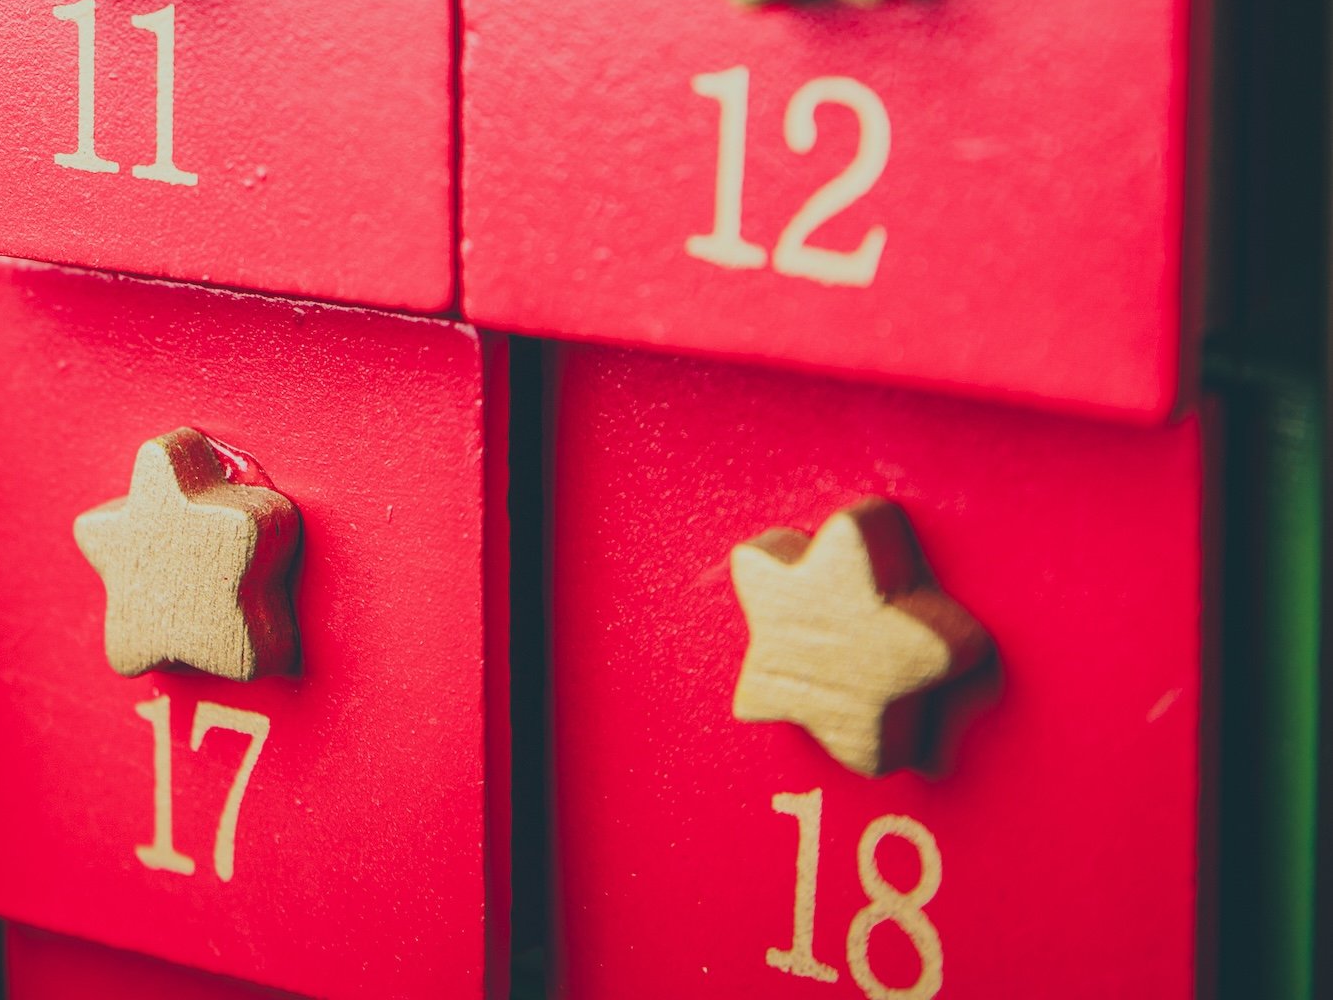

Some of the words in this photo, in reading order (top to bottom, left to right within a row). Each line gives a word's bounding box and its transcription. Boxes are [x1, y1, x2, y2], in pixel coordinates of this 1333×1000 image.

[684, 66, 891, 287] 12
[134, 695, 271, 881] 17
[765, 788, 944, 1000] 18
